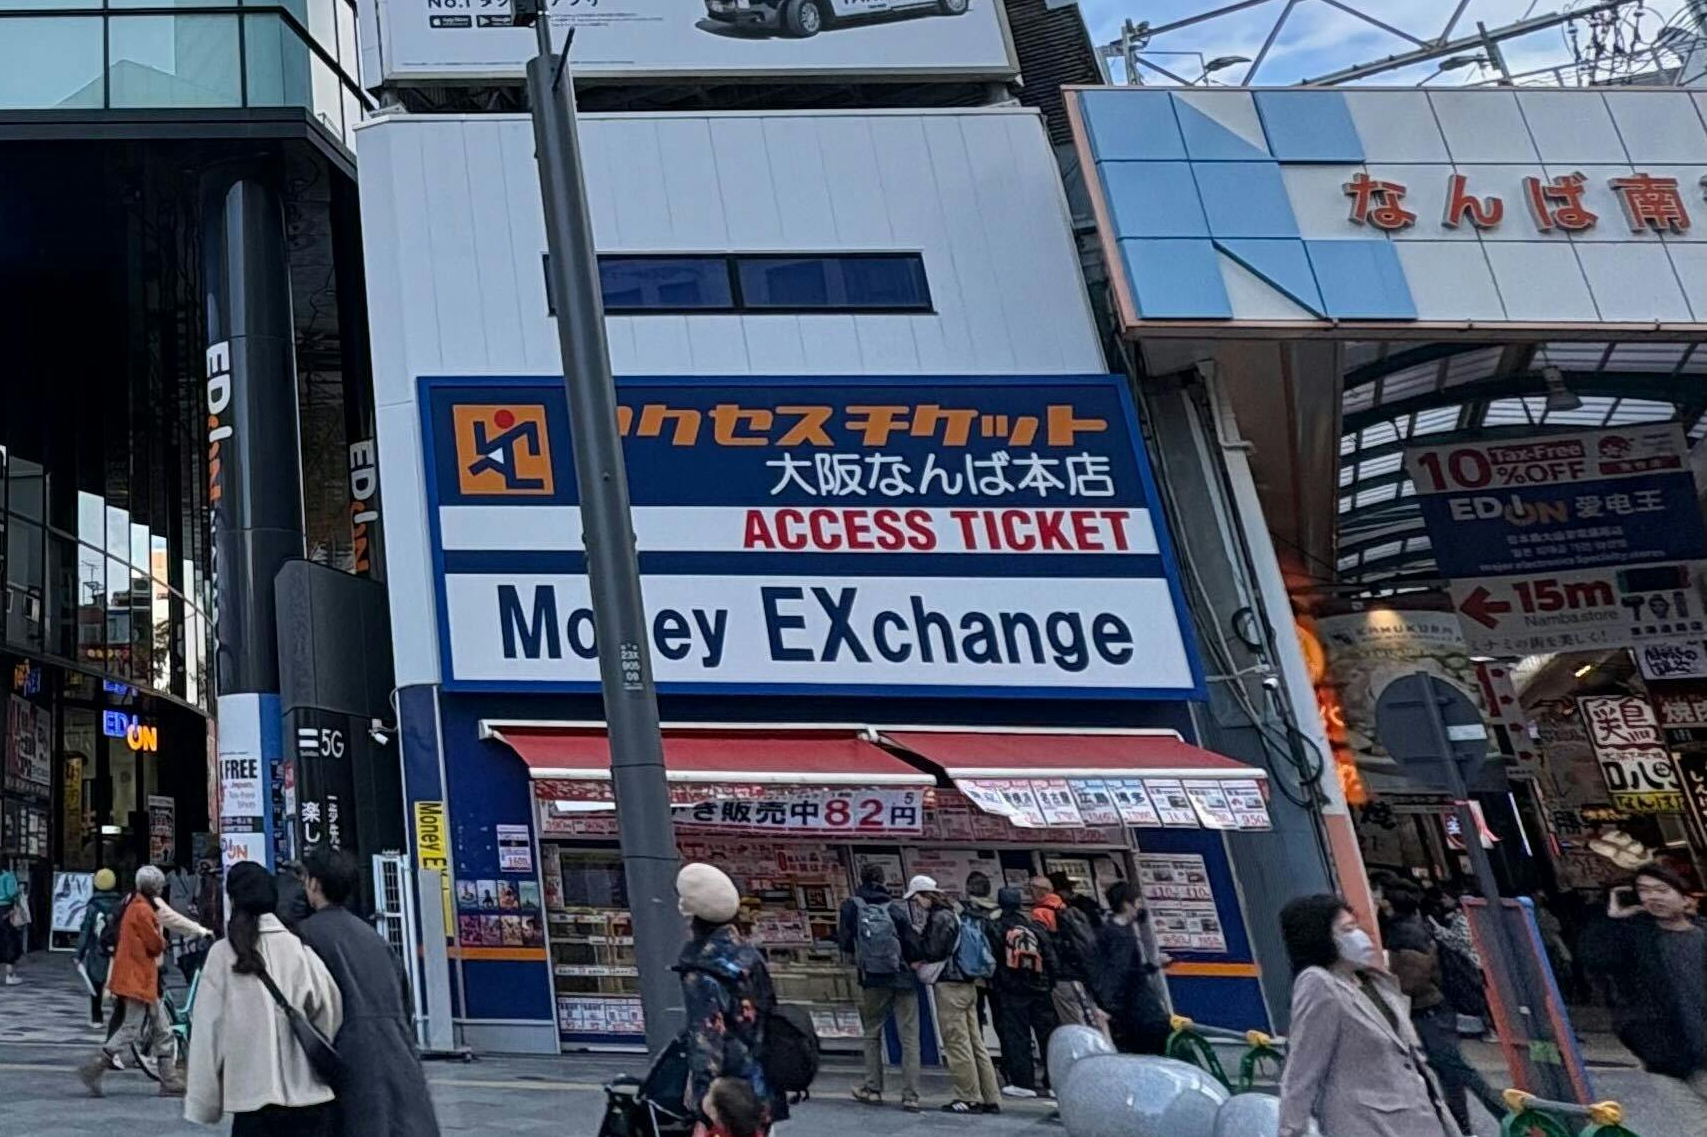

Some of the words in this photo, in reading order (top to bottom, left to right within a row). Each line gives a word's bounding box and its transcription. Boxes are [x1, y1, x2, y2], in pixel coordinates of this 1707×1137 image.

[1343, 172, 1707, 233] なんば南
[1418, 448, 1493, 491] 10
[1492, 440, 1583, 464] Tax-Free
[766, 452, 1115, 497] 大阪なんば本店
[1497, 461, 1584, 486] %OFF
[743, 509, 937, 551] ACCESS
[950, 509, 1131, 551] TICKET
[1447, 494, 1568, 526] EDION
[1512, 579, 1616, 612] 15m
[497, 584, 728, 668] Moey
[761, 585, 1135, 673] EXchange
[103, 709, 158, 752] EDION
[321, 728, 344, 758] 5G
[302, 801, 321, 857] 楽し
[419, 802, 443, 853] Money
[824, 798, 884, 827] 82
[890, 806, 916, 826] 円
